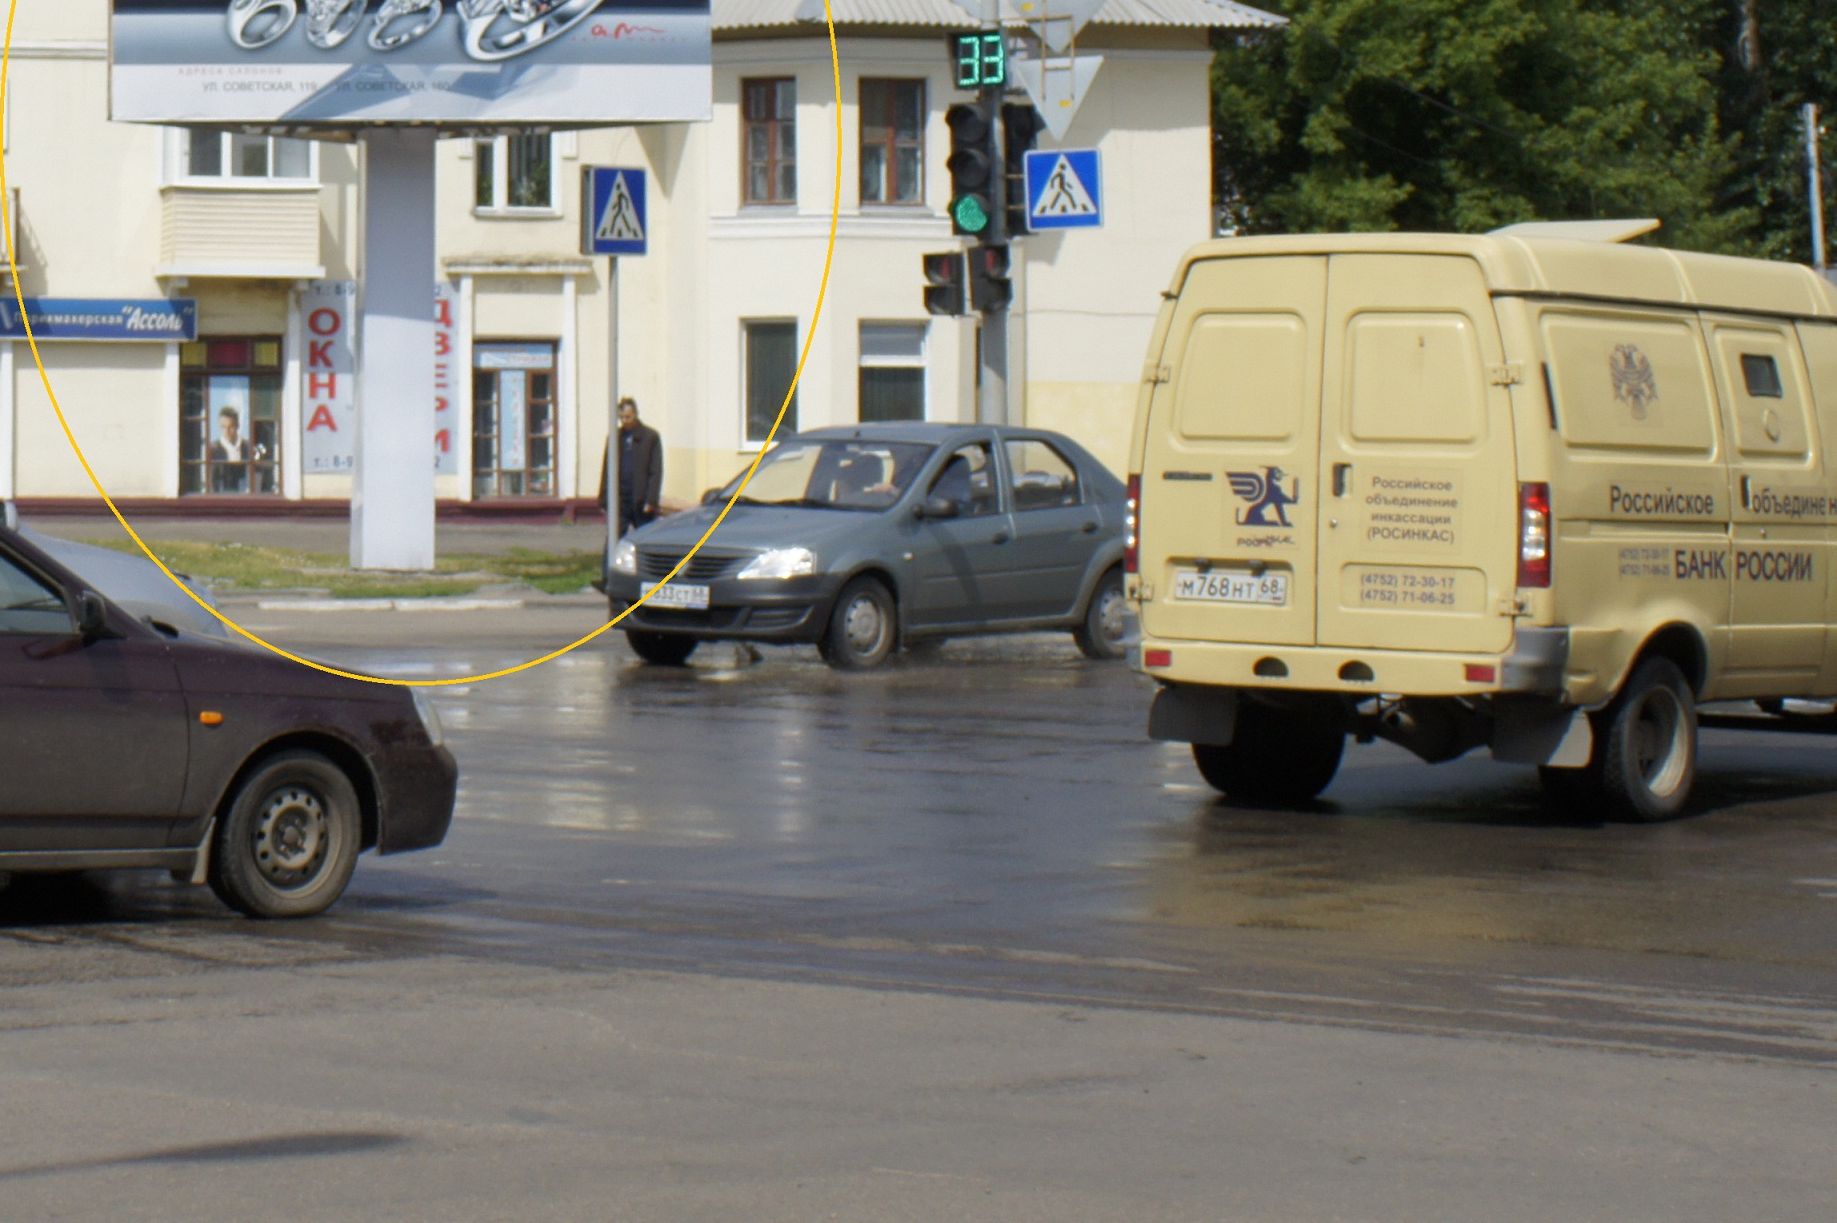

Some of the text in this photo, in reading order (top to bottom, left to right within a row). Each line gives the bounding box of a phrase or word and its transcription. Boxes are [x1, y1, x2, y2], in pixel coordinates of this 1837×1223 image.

[959, 35, 1003, 85] 33
[306, 307, 341, 431] ОКНА
[1372, 476, 1453, 491] Российское
[1365, 493, 1458, 508] объединение
[1609, 485, 1714, 515] Российское
[1371, 513, 1452, 525] инкассации
[1367, 526, 1455, 544] (РОСИНКАС)
[1675, 549, 1812, 581] БАНК РОССИИ
[1260, 579, 1279, 594] 68
[1361, 573, 1455, 588] (4752) 72-30-17
[1361, 589, 1455, 605] (4752) 71-06-25
